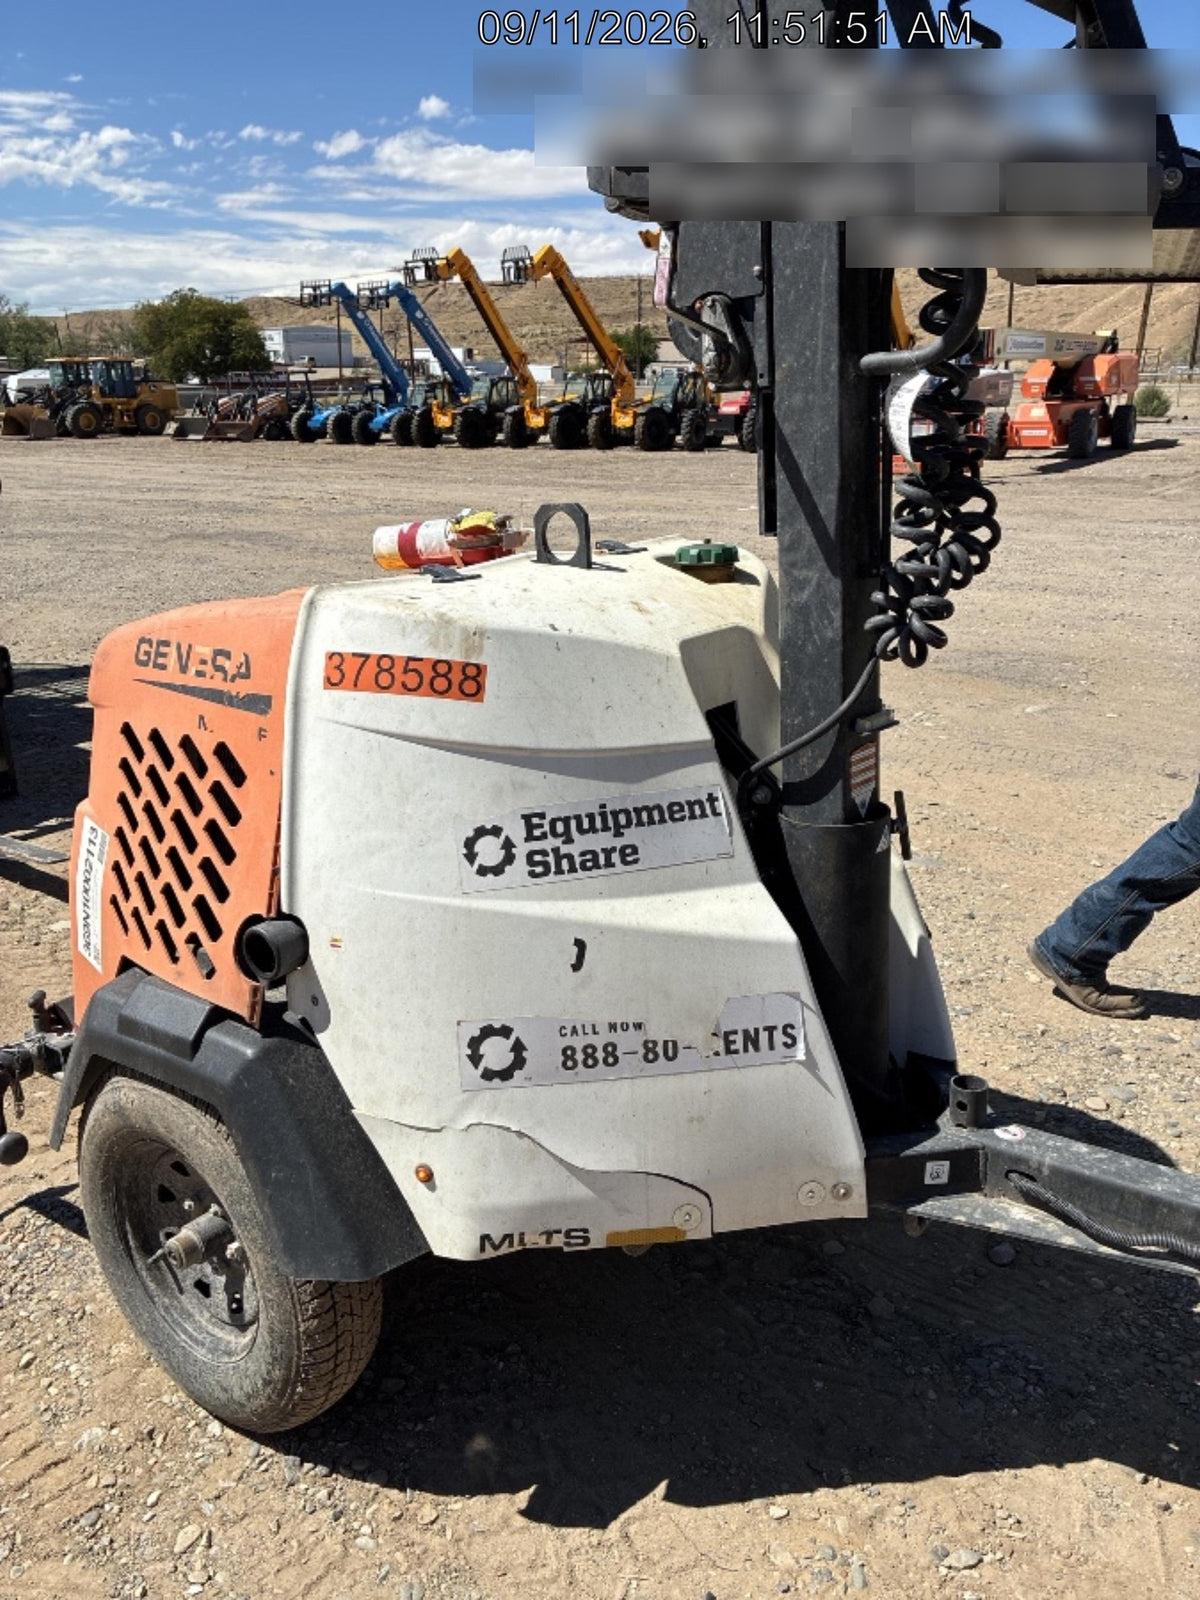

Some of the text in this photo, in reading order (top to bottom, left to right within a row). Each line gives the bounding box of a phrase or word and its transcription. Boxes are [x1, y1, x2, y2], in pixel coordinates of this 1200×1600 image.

[326, 652, 484, 699] 378588
[521, 792, 721, 845] Equipment
[525, 842, 641, 877] Share
[559, 1021, 645, 1038] CALL NOW
[561, 1024, 797, 1071] 888-80-ENTS
